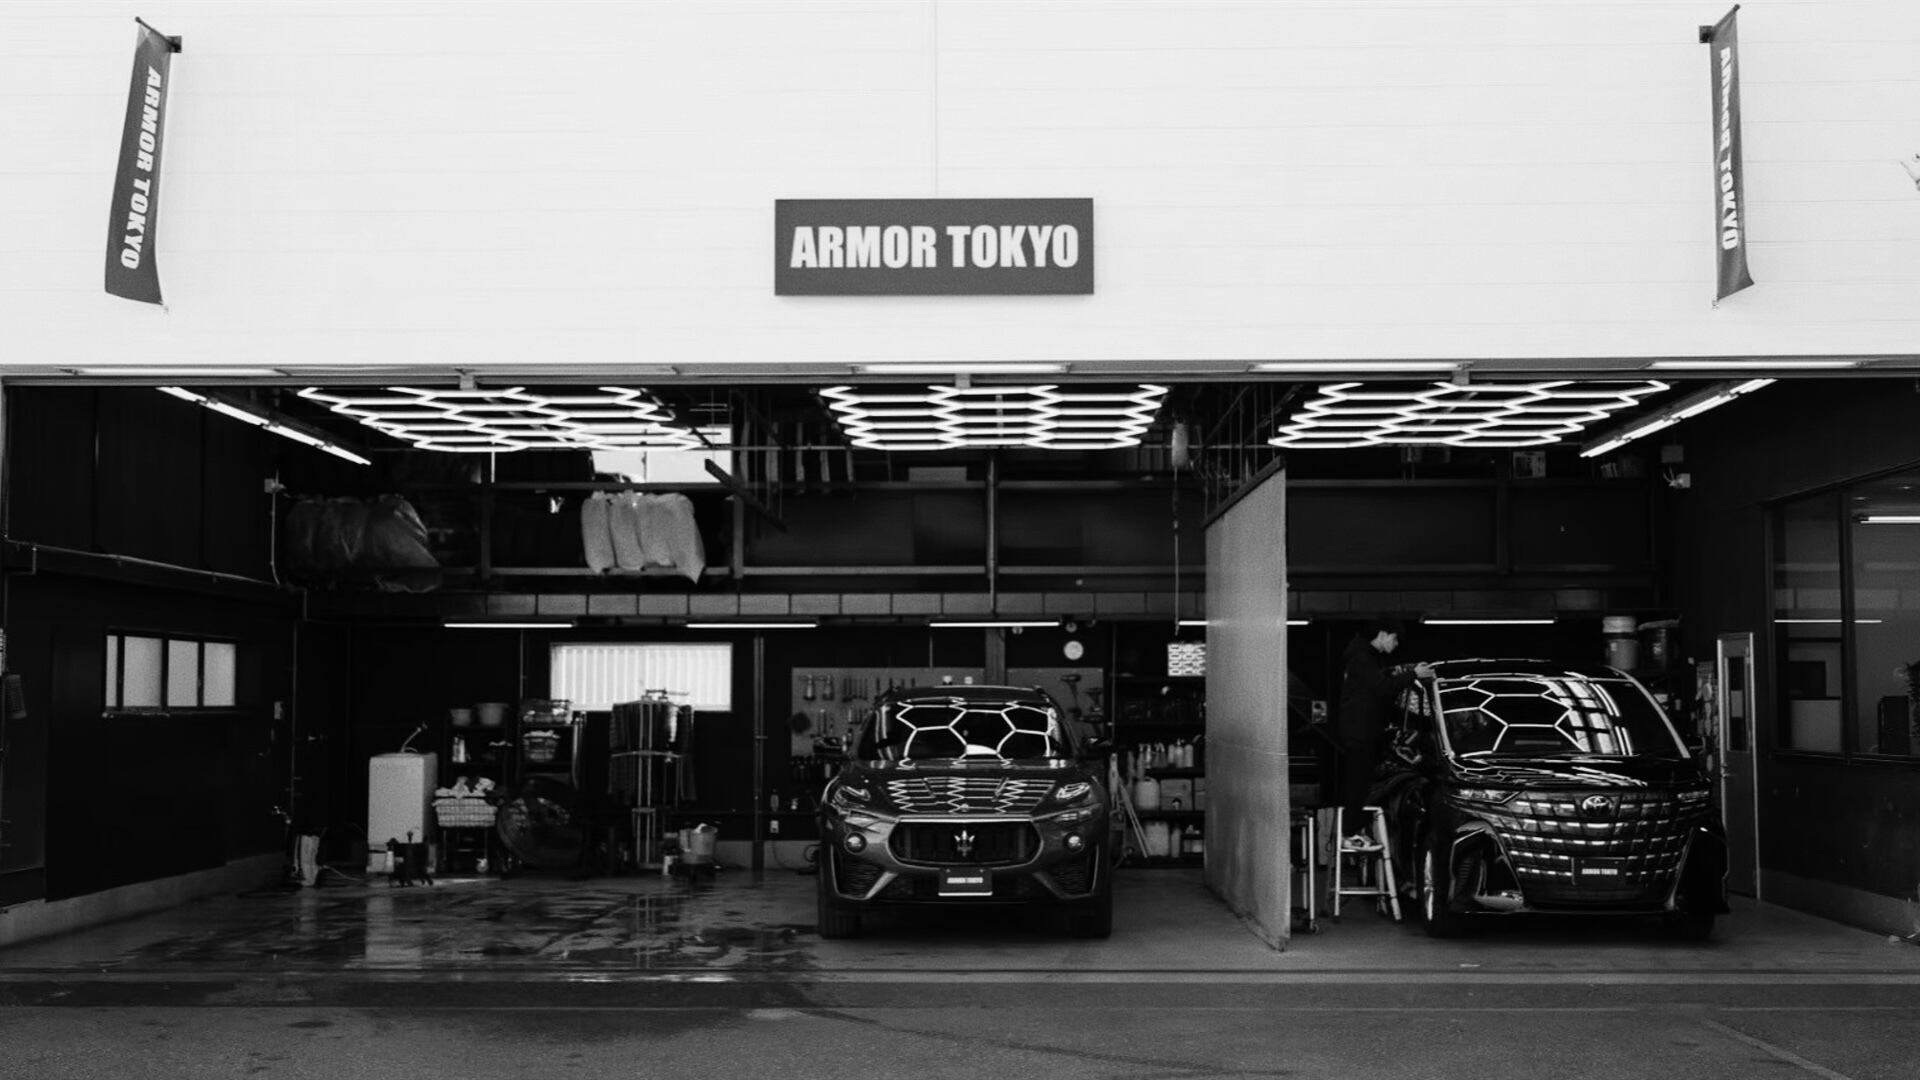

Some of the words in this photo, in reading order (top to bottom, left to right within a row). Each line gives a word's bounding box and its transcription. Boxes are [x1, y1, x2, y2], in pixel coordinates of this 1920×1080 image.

[136, 65, 162, 172] ARMOR
[121, 178, 151, 270] TOKYO
[790, 225, 937, 269] ARMOR
[946, 224, 1079, 269] TOKYO
[1719, 153, 1739, 250] TOKYO
